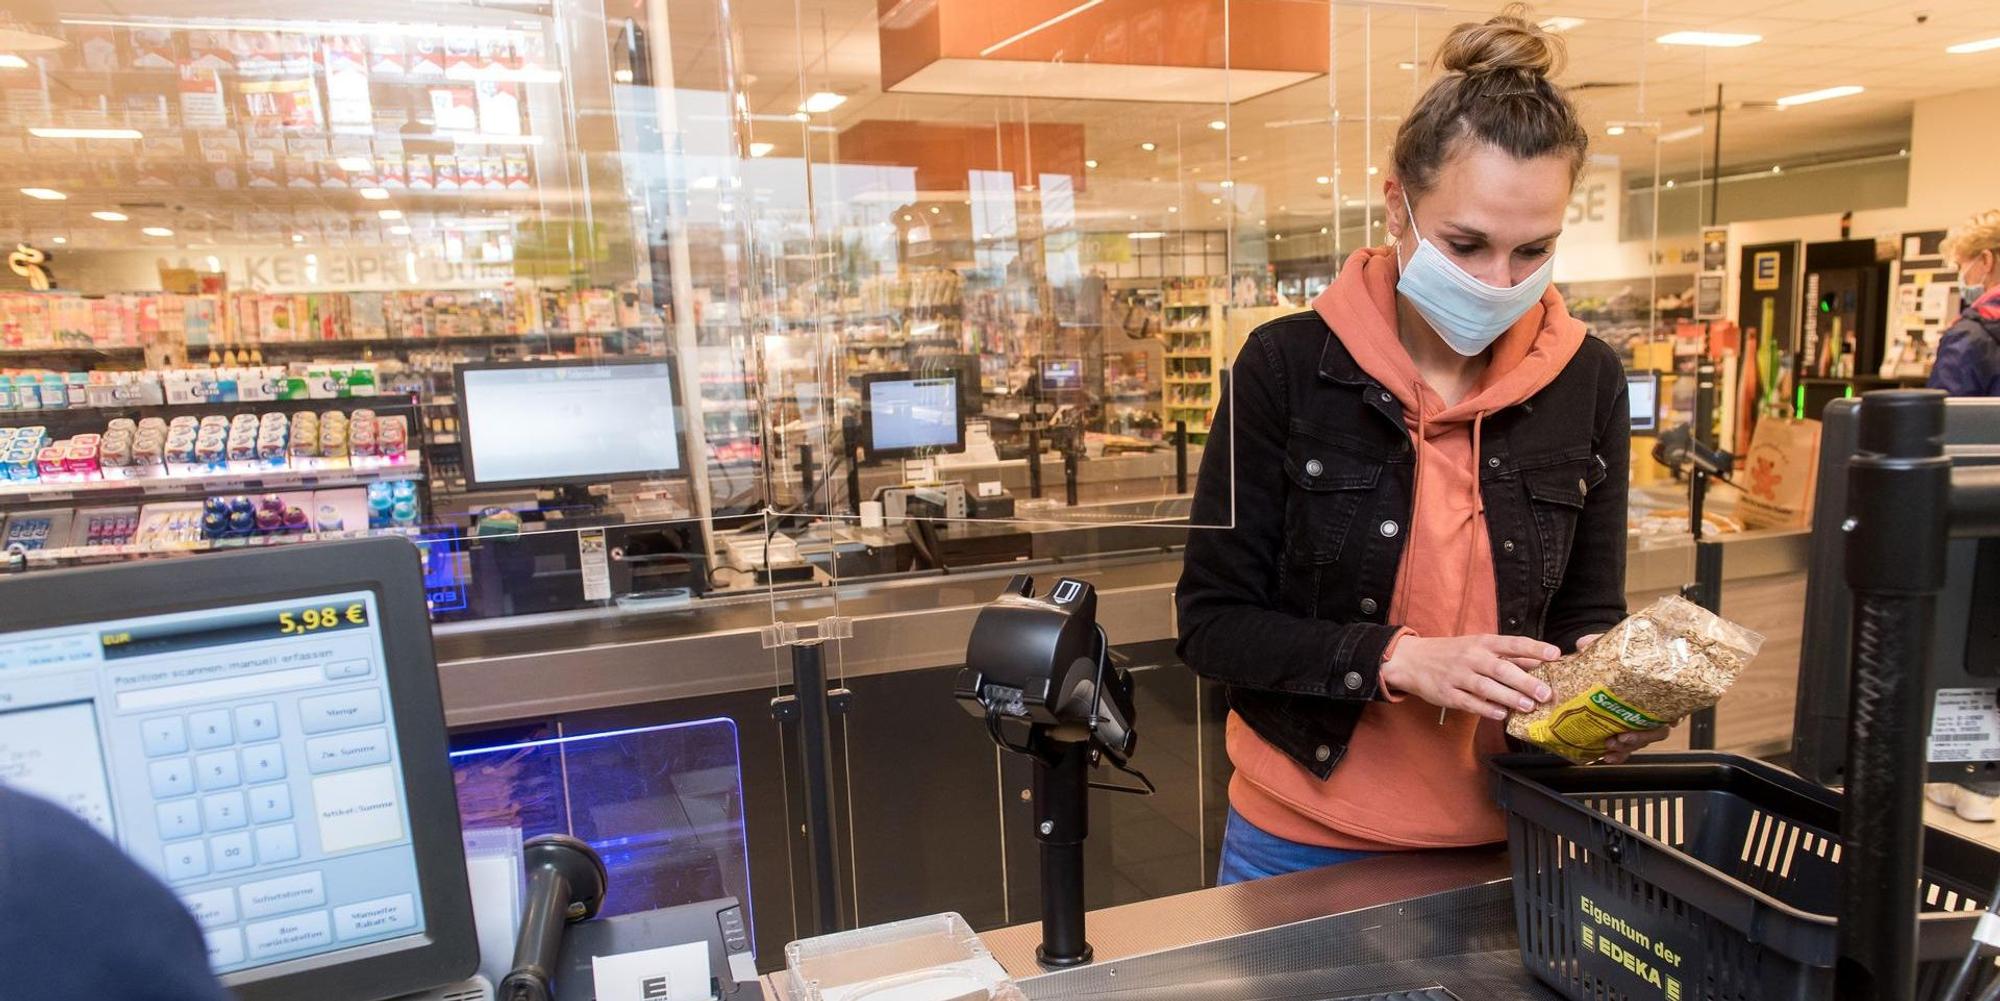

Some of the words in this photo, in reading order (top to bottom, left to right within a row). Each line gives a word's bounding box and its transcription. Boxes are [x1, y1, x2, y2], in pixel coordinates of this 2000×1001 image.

[278, 606, 339, 635] 5,98
[345, 603, 366, 625] €
[102, 632, 130, 645] EUR
[114, 671, 168, 686] Position
[281, 649, 333, 664] erfassen
[340, 745, 376, 756] Summe
[1580, 895, 1651, 951] Eigentum
[1653, 941, 1682, 968] der
[1598, 934, 1662, 990] EDEKA
